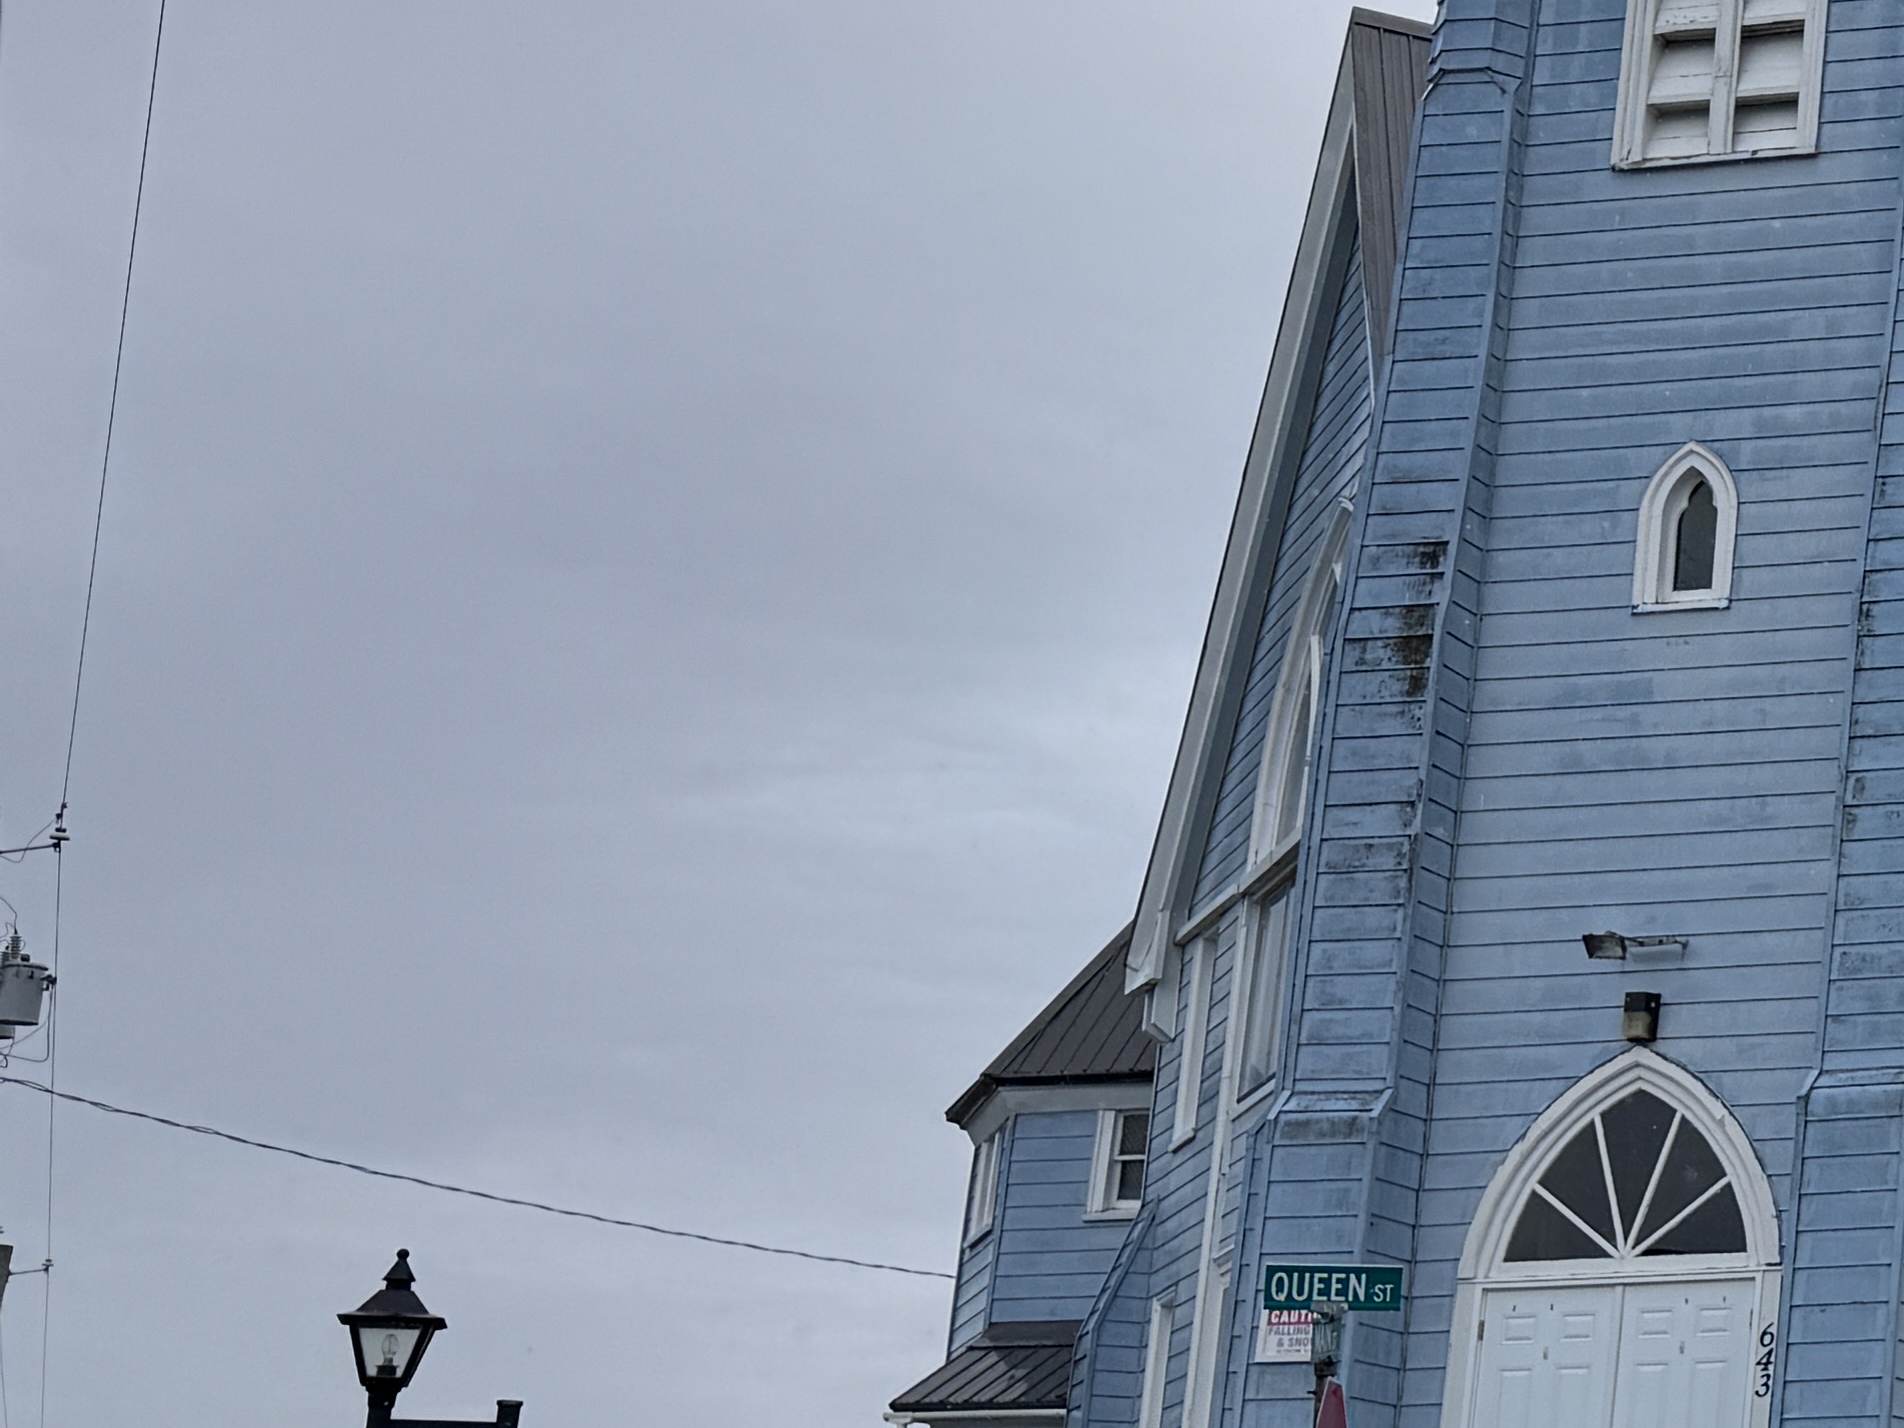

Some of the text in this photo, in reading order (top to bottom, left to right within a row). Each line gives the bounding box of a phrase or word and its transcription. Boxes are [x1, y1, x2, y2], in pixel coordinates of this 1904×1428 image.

[1270, 1272, 1394, 1303] QUEEN ST
[1268, 1325, 1311, 1336] FALLING
[1287, 1337, 1309, 1348] SNO
[1754, 1321, 1775, 1399] 643
